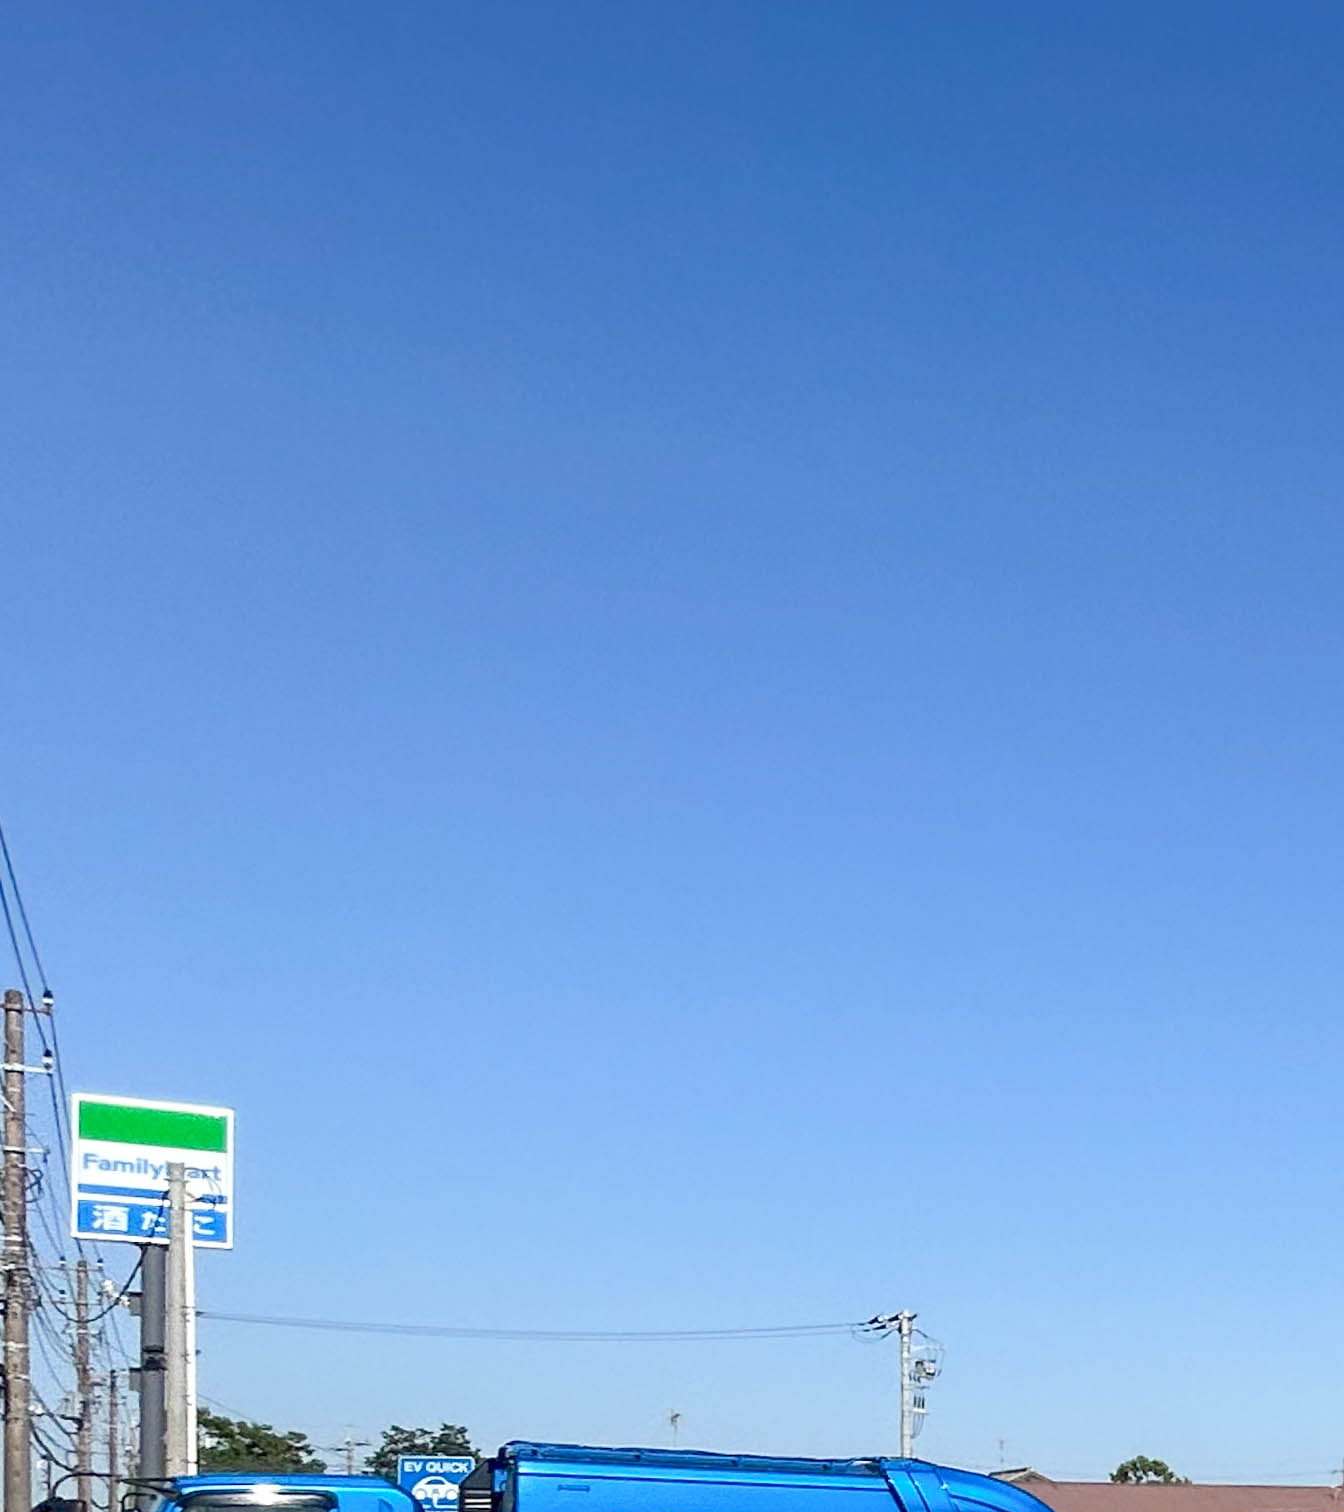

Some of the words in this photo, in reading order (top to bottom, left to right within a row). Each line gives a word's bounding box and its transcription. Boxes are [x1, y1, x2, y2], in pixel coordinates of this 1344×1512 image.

[83, 1152, 222, 1181] Familyart
[91, 1204, 130, 1233] 酒
[140, 1210, 216, 1236] たこ
[403, 1461, 423, 1473] EV
[425, 1461, 469, 1474] QUICK
